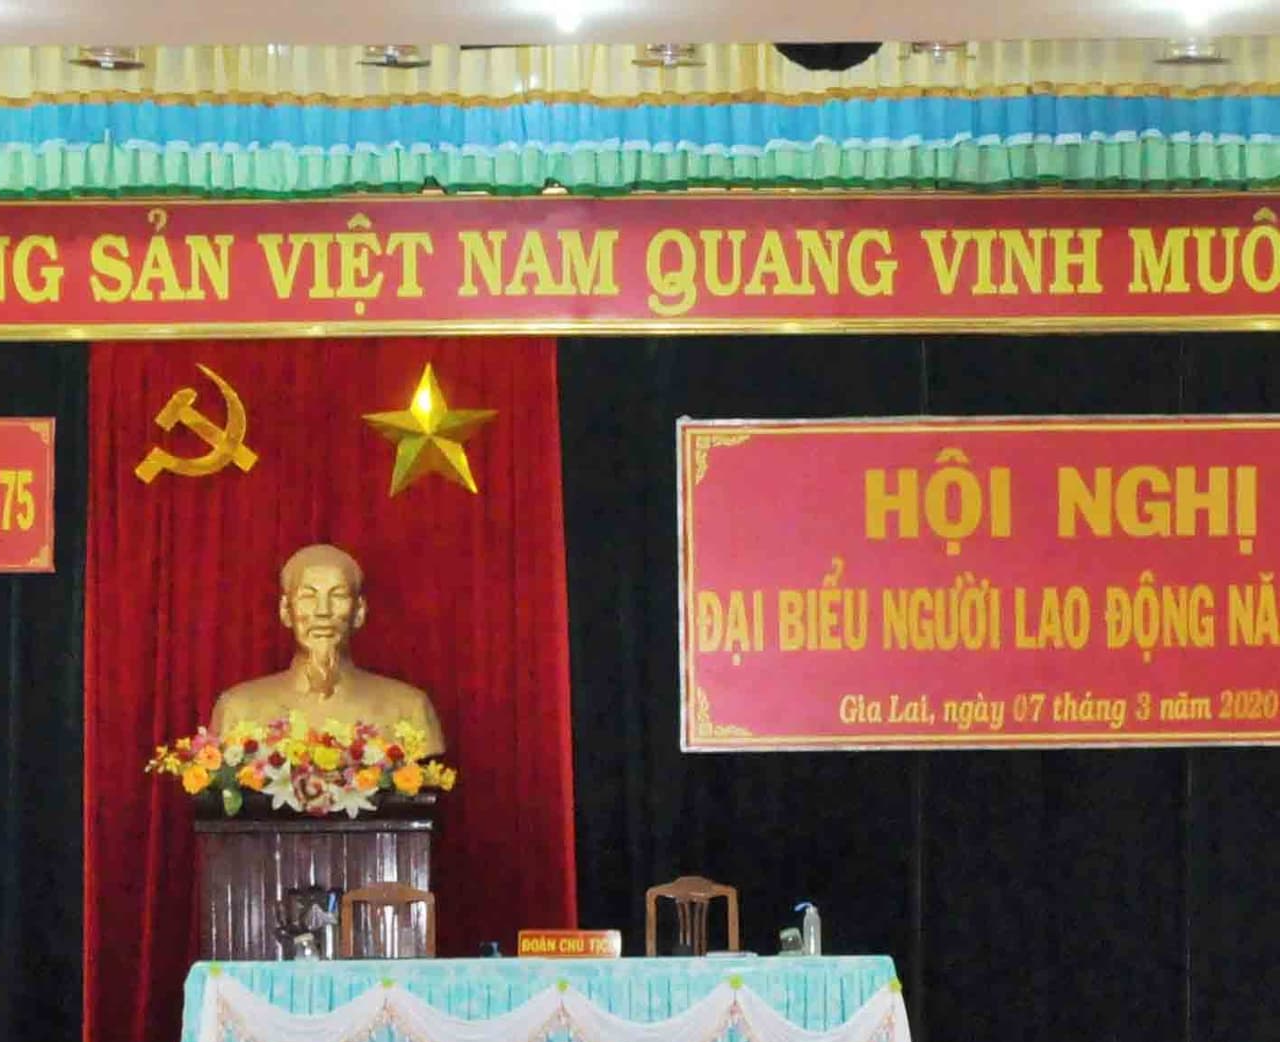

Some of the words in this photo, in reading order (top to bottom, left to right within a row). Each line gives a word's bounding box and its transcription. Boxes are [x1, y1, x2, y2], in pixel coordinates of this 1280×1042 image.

[90, 210, 233, 304] SẢN
[258, 214, 433, 314] VIỆT
[456, 229, 619, 296] NAM
[645, 229, 897, 312] QUANG
[922, 228, 1103, 296] VINH
[1, 472, 34, 530] 75
[864, 449, 1011, 555] HỘI
[1057, 467, 1258, 555] NGHỊ
[696, 590, 764, 665] ĐẠI
[779, 558, 868, 651] BIỂU
[883, 572, 1001, 651] NGƯỜI
[1014, 586, 1090, 649] LAO
[1105, 570, 1214, 663] ĐỘNG
[839, 696, 881, 723] Gia
[888, 696, 935, 724] Lai,
[944, 693, 1005, 729] ngày
[1013, 694, 1046, 722] 07
[1052, 692, 1128, 728] tháng
[1136, 692, 1151, 720] 3
[1159, 693, 1212, 720] năm
[1219, 690, 1279, 720] 2020
